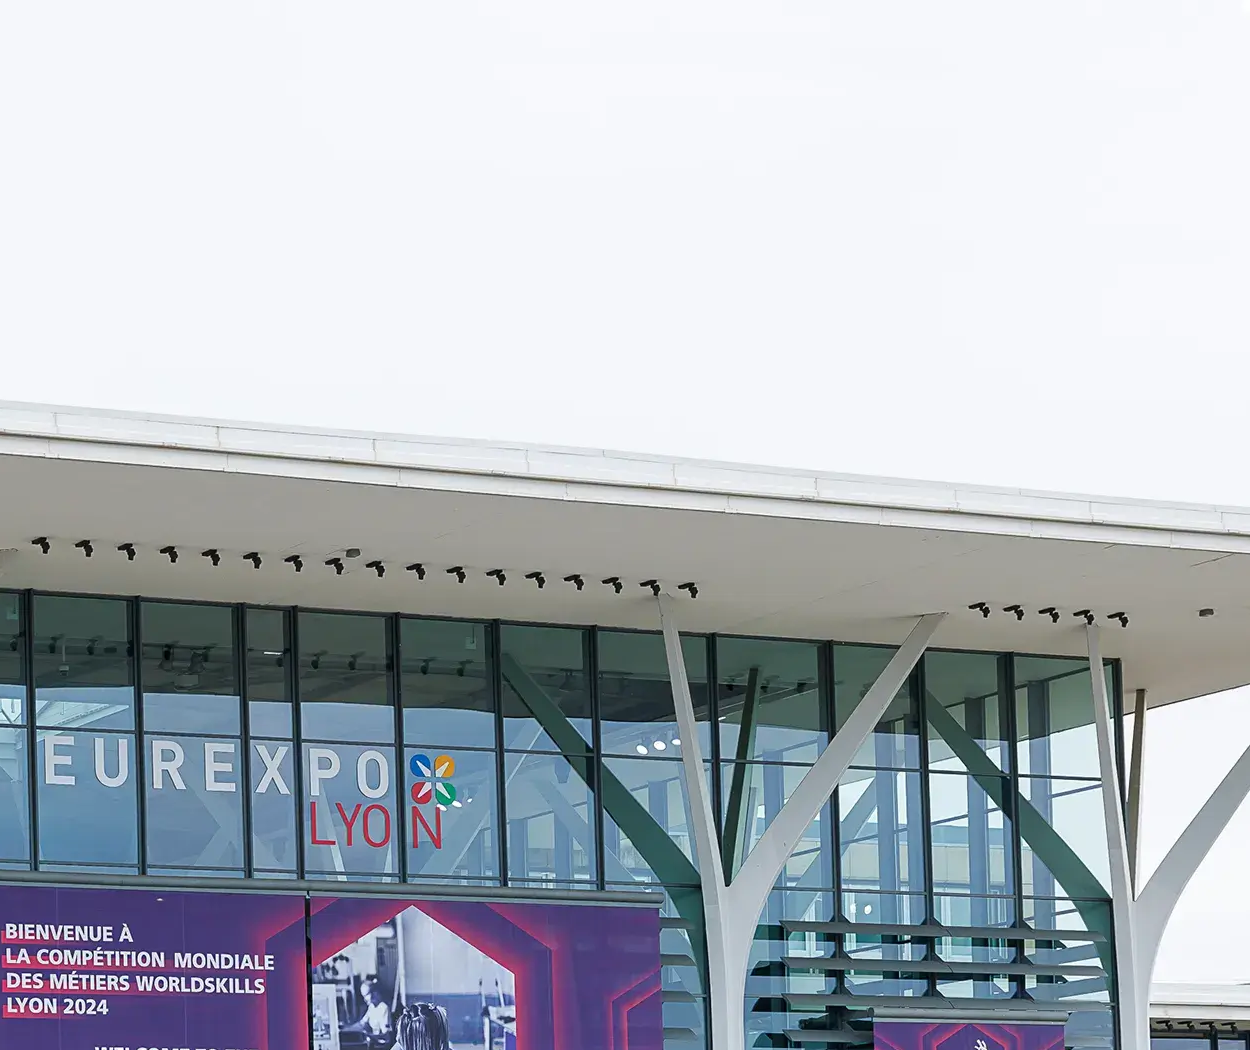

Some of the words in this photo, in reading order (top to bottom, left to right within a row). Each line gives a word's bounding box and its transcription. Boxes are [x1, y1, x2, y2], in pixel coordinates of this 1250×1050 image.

[43, 735, 390, 799] EUREXPO
[310, 801, 443, 850] LYON
[5, 923, 113, 942] BIENVENUE
[119, 923, 134, 943] À
[6, 948, 31, 964] LA
[36, 947, 165, 968] COMPÉTITION
[174, 952, 275, 971] MONDIALE
[6, 972, 43, 989] DES
[50, 971, 130, 991] MÉTIERS
[136, 975, 265, 994] WORLDSKILLS
[7, 997, 57, 1014] LYON
[63, 998, 109, 1015] 2024
